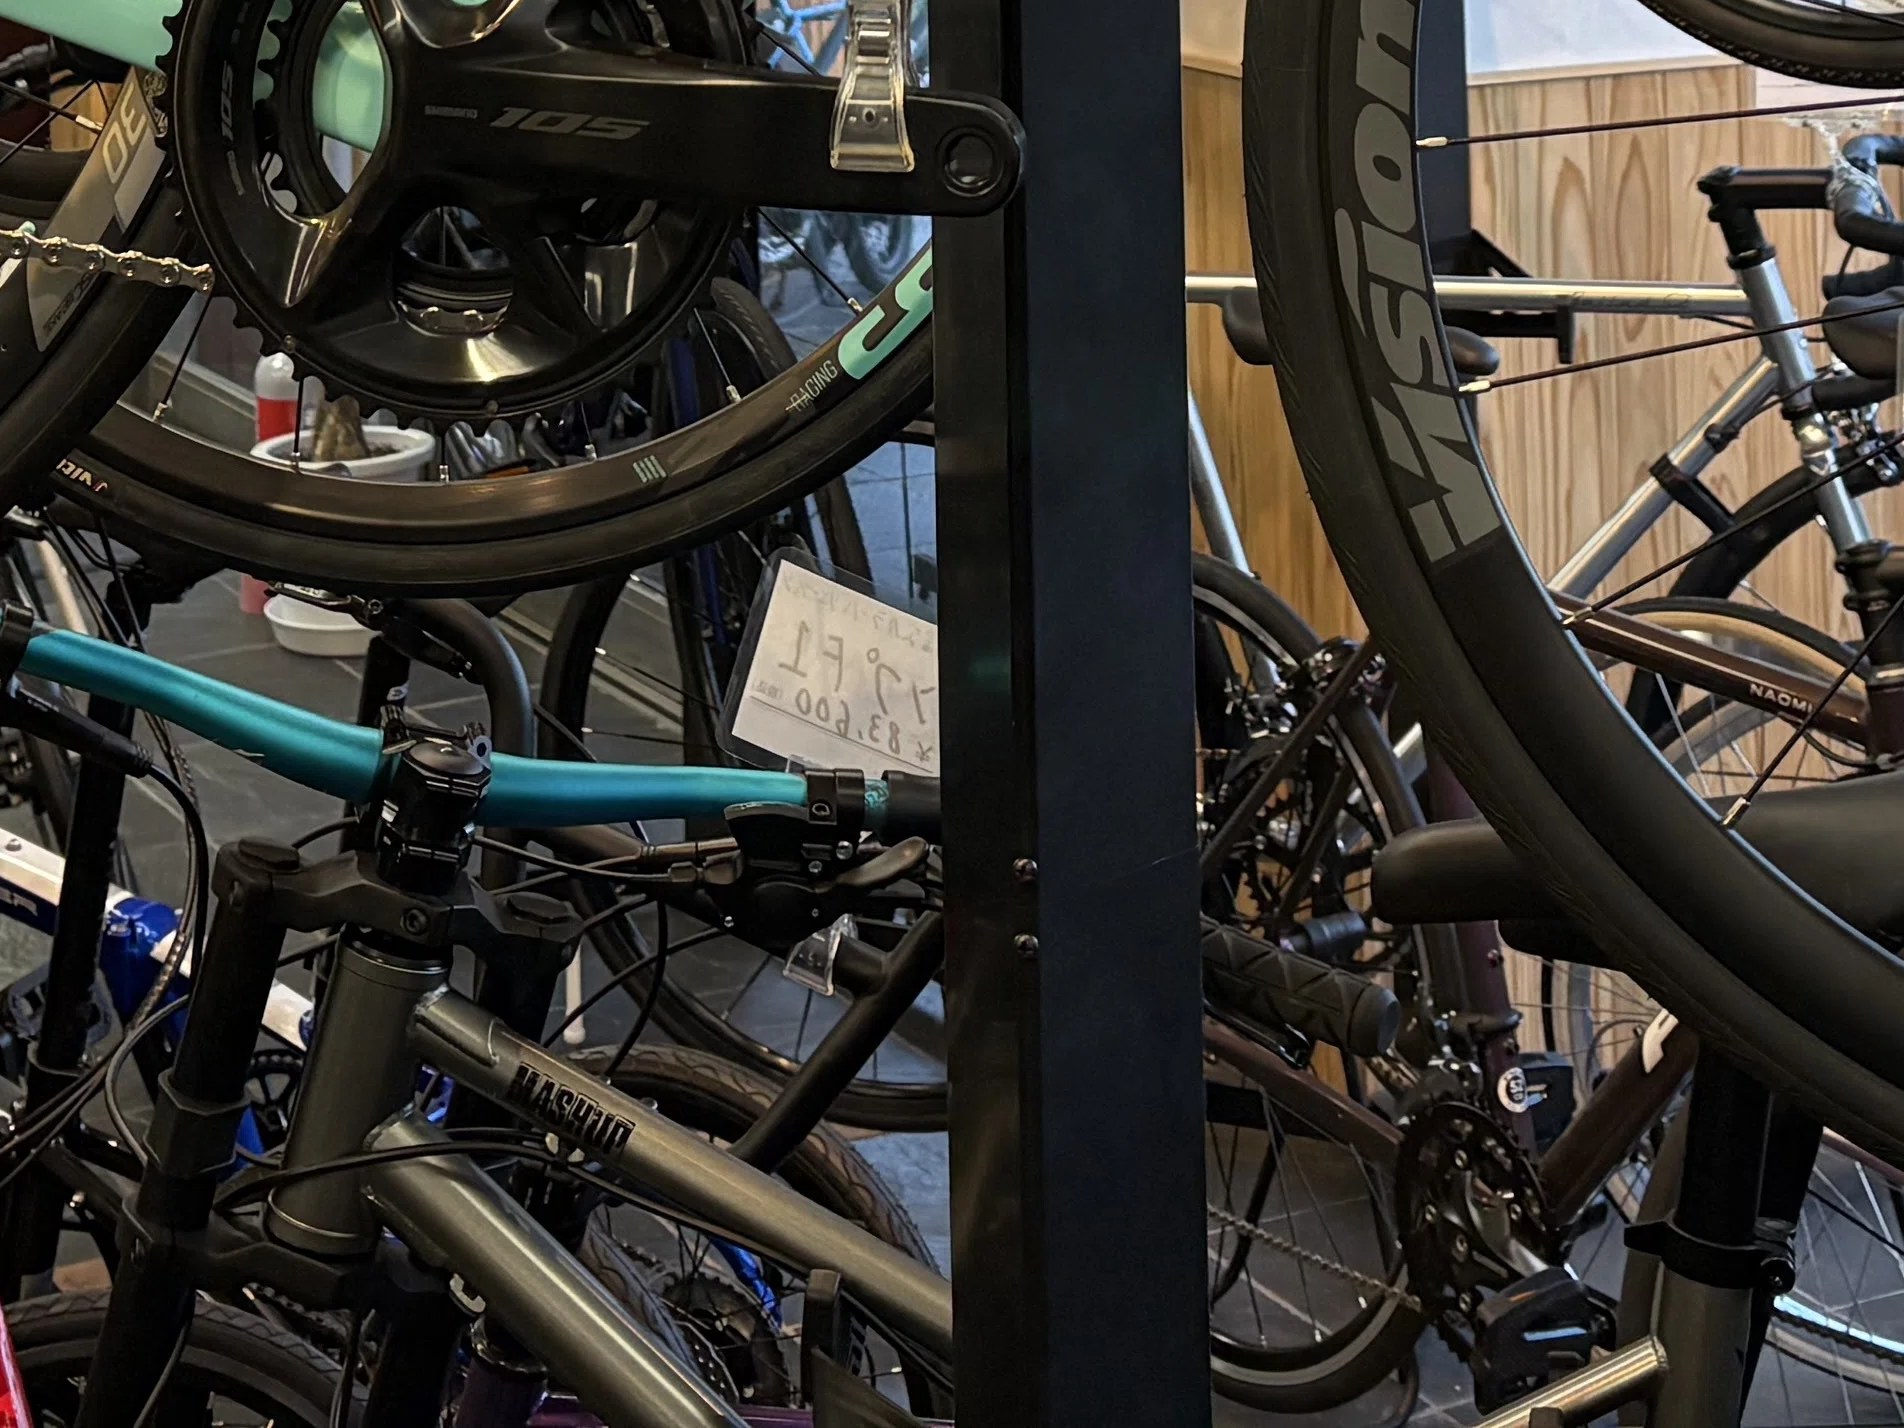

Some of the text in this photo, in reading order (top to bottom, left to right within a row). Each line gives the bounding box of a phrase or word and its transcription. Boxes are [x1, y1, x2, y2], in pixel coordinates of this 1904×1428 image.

[102, 82, 146, 185] 30
[489, 105, 652, 141] 105
[789, 359, 839, 413] RACING
